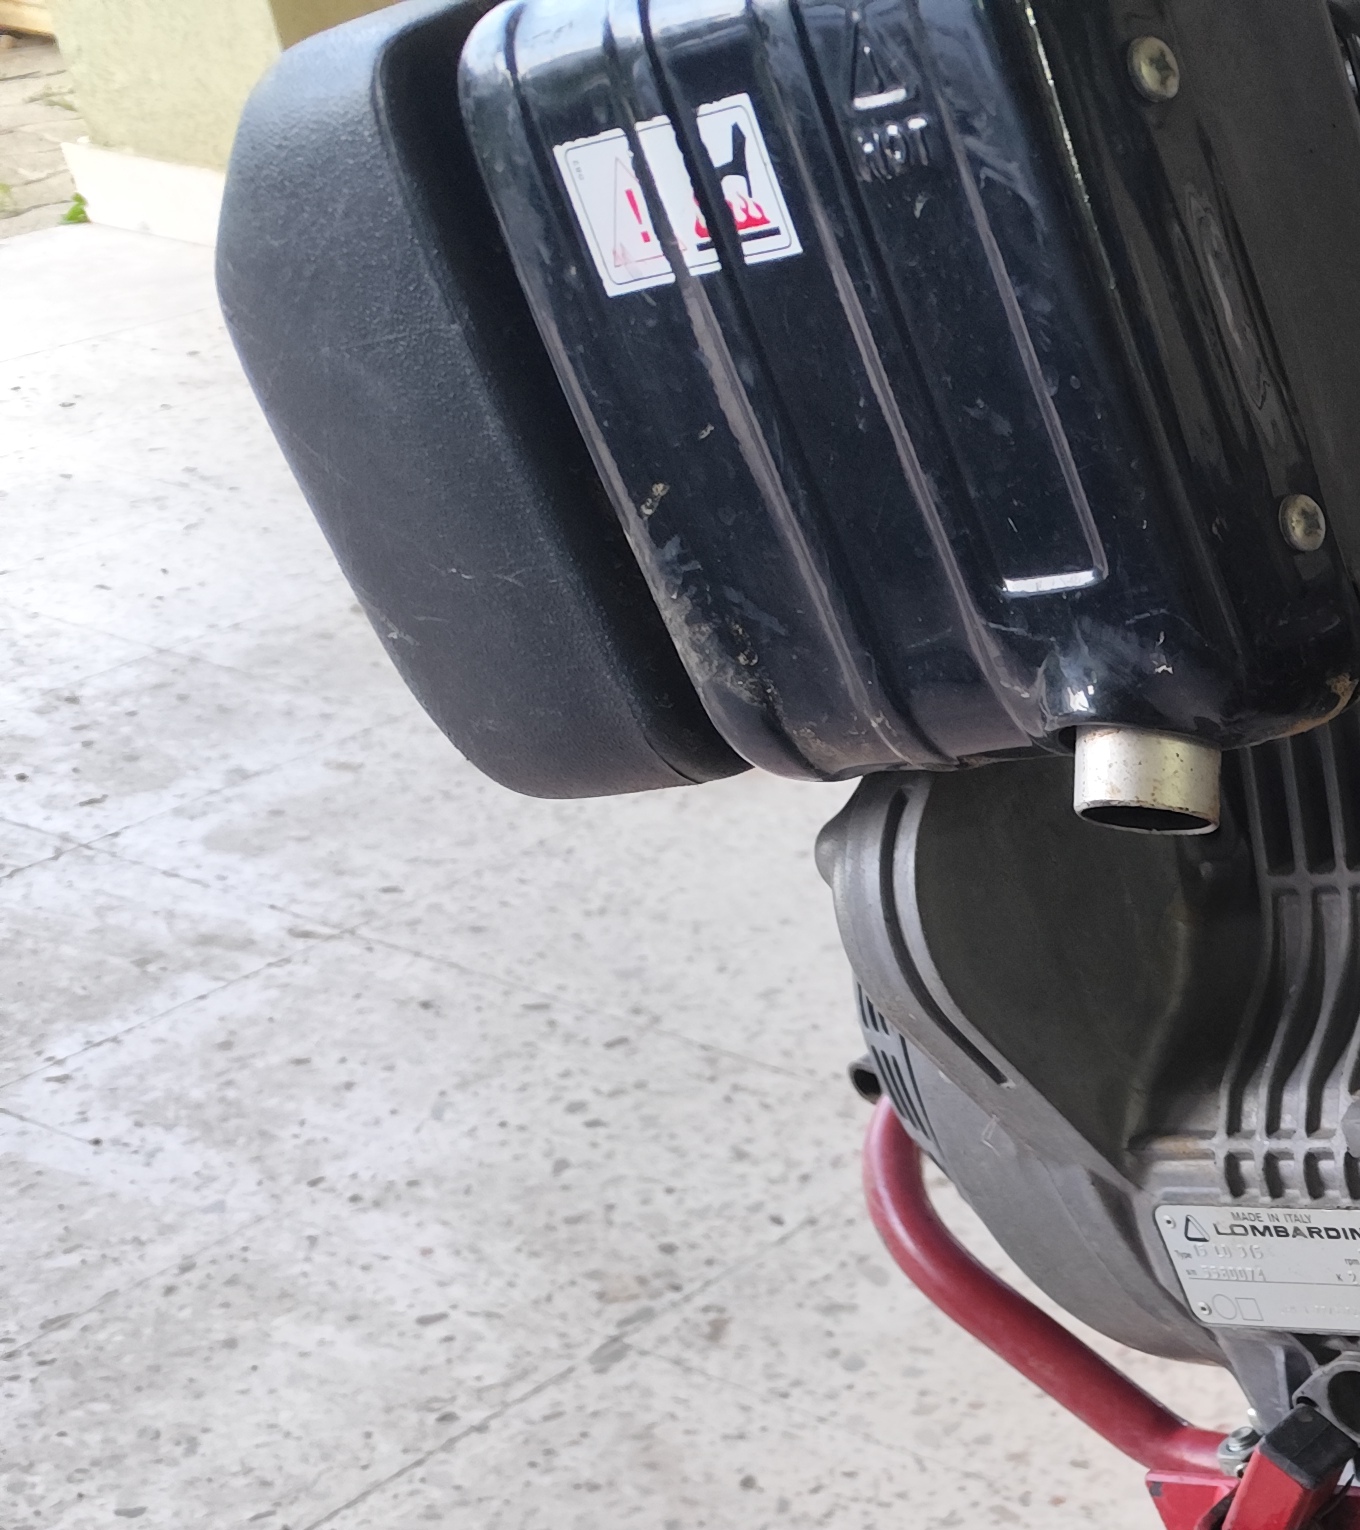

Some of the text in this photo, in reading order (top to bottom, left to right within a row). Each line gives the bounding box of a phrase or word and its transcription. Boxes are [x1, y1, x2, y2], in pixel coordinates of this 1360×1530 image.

[851, 116, 929, 182] HOT
[1230, 1212, 1312, 1224] MADE IN ITALY
